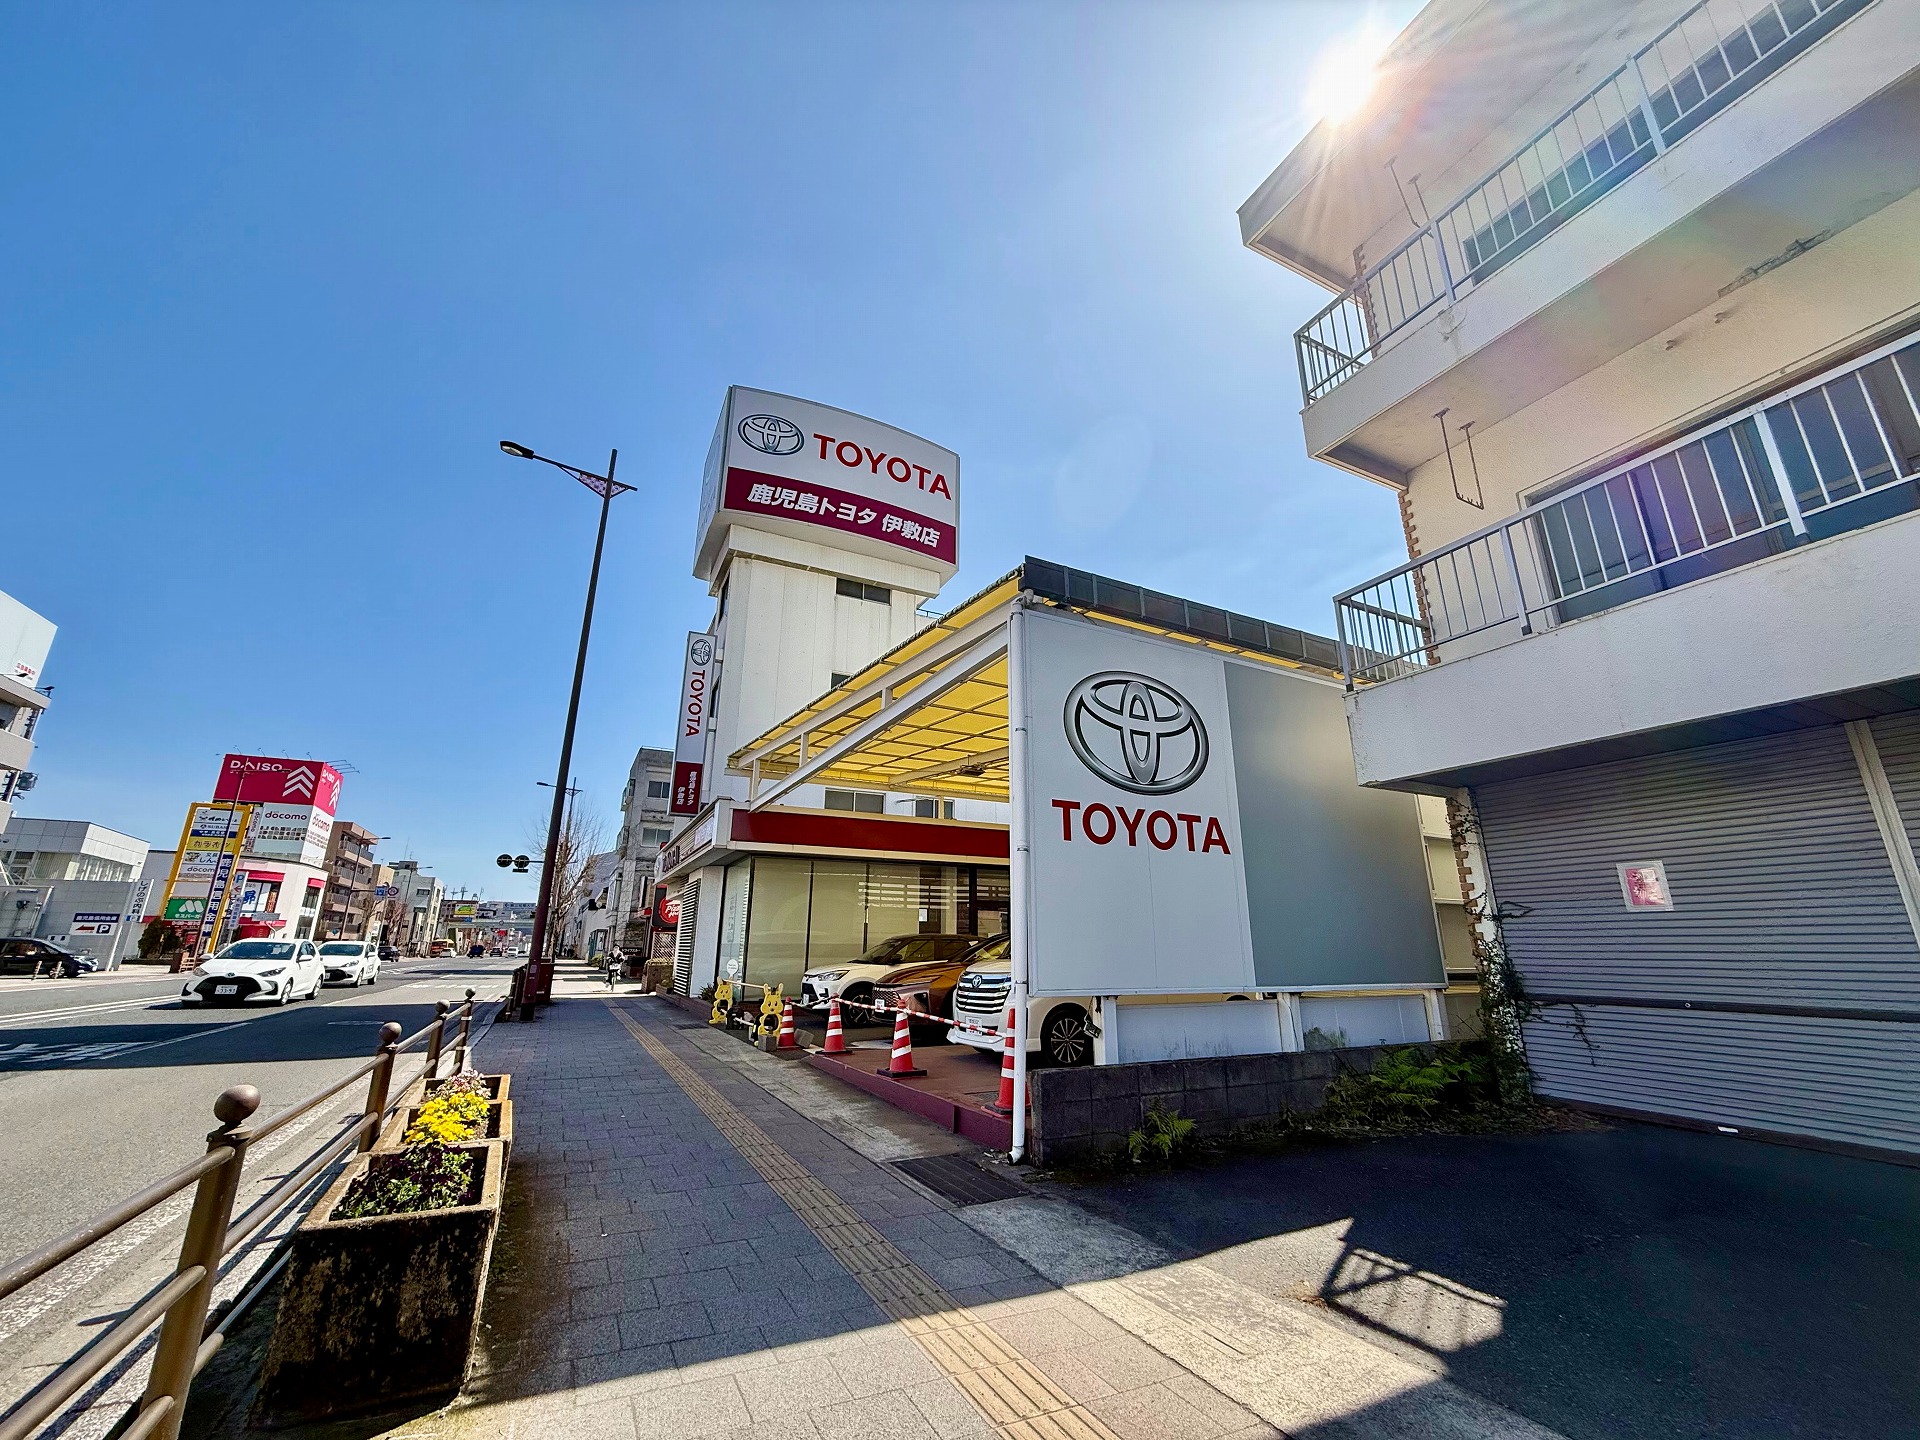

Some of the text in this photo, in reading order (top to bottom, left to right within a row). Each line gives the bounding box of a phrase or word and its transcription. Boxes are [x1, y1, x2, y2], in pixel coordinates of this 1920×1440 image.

[813, 433, 952, 501] TOYOTA
[747, 482, 941, 548] 鹿児島トヨタ 伊敷店
[685, 669, 706, 737] TOYOTA
[230, 760, 283, 772] DAISO
[265, 811, 308, 821] docomo
[1051, 799, 1231, 855] TOYOTA
[236, 875, 245, 883] P
